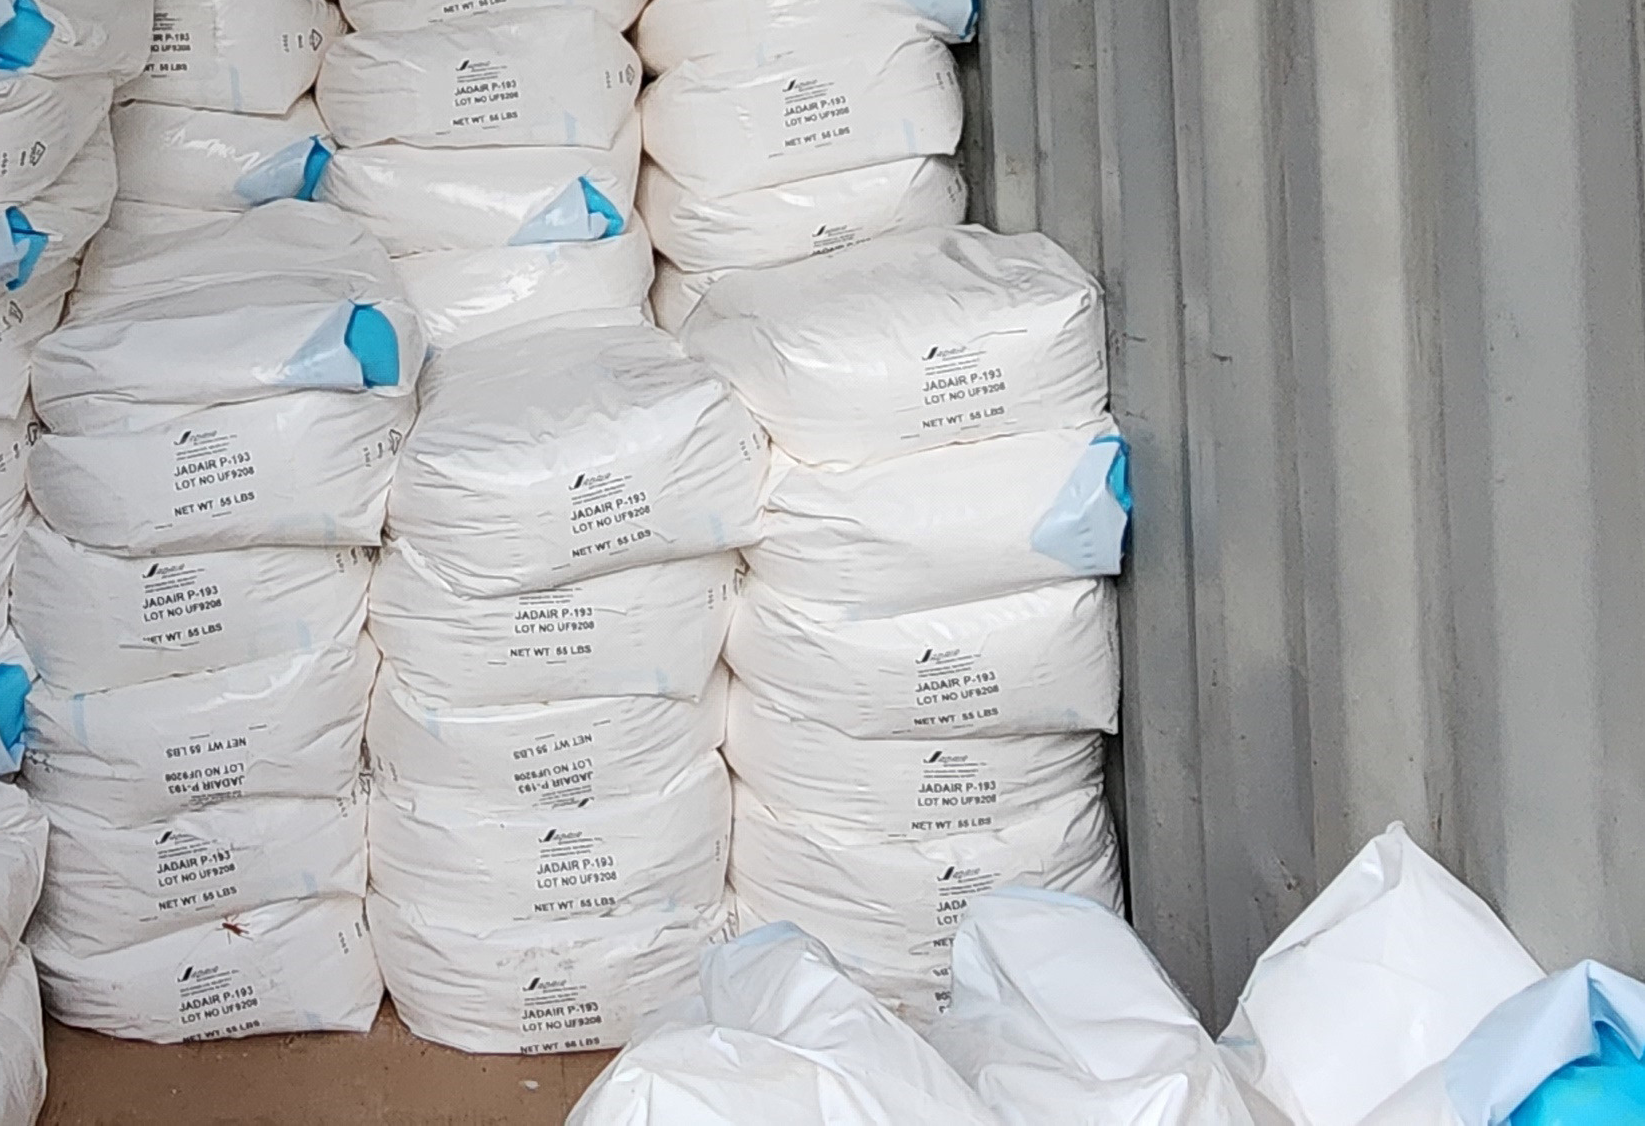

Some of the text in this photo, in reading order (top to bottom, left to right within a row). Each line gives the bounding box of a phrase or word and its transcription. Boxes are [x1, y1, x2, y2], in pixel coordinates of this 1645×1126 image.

[923, 368, 1002, 392] JADAIR P-193
[925, 382, 1005, 405] LOT NO UF9208
[922, 418, 943, 428] NET
[946, 414, 963, 424] WT
[984, 406, 1005, 417] LBS
[174, 452, 250, 477] JADAIR P-193
[175, 466, 254, 491] LOT NO UF9208
[174, 504, 194, 516] NET
[197, 500, 213, 511] WT
[234, 492, 254, 503] LBS
[571, 492, 646, 521] JADAIR P-193
[572, 505, 650, 534] LOT NO UF9208
[572, 546, 592, 557] NET
[595, 541, 610, 551] WT
[631, 530, 651, 542] LBS
[143, 586, 218, 609] JADAIR P-193
[144, 598, 222, 622] LOT NO UF9208
[515, 608, 592, 620] JADAIR P-193
[165, 632, 181, 641] WT
[201, 623, 222, 635] LBS
[515, 621, 594, 633] LOT NO UF9208
[510, 648, 530, 656] NET
[534, 648, 550, 656] WT
[570, 645, 591, 655] LBS
[916, 671, 996, 692] JADAIR P-193
[917, 684, 999, 705] LOT NO UF9208
[914, 717, 935, 725] NET
[938, 715, 955, 723] WT
[977, 708, 999, 718] LBS
[208, 742, 223, 751] WT
[226, 738, 246, 749] NET
[554, 740, 570, 751] WT
[573, 734, 592, 746] NET
[166, 747, 187, 758] LBS
[513, 748, 534, 760] LBS
[165, 763, 244, 782] LOT NO UF9208
[514, 758, 592, 781] LOT NO UF9208
[168, 775, 244, 794] JADAIR P-193
[518, 771, 593, 794] JADAIR P-193
[919, 781, 996, 793] JADAIR P-193
[918, 797, 939, 806] LOT
[942, 797, 958, 806] NO
[157, 850, 230, 874] JADAIR P-193
[537, 856, 613, 875] JADAIR P-193
[158, 863, 235, 887] LOT NO UF9208
[537, 871, 617, 888] LOT NO UF9208
[159, 899, 178, 910] NET
[180, 895, 196, 906] WT
[216, 886, 237, 898] LBS
[534, 902, 554, 912] NET
[558, 900, 573, 910] WT
[594, 897, 616, 907] LBS
[936, 899, 967, 912] JADA
[937, 915, 958, 926] LOT
[179, 986, 253, 1012] JADAIR P-193
[181, 1012, 201, 1024] LOT
[204, 1008, 219, 1018] NO
[522, 1002, 598, 1019] JADAIR P-193
[523, 1022, 542, 1032] LOT
[546, 1021, 562, 1030] NO
